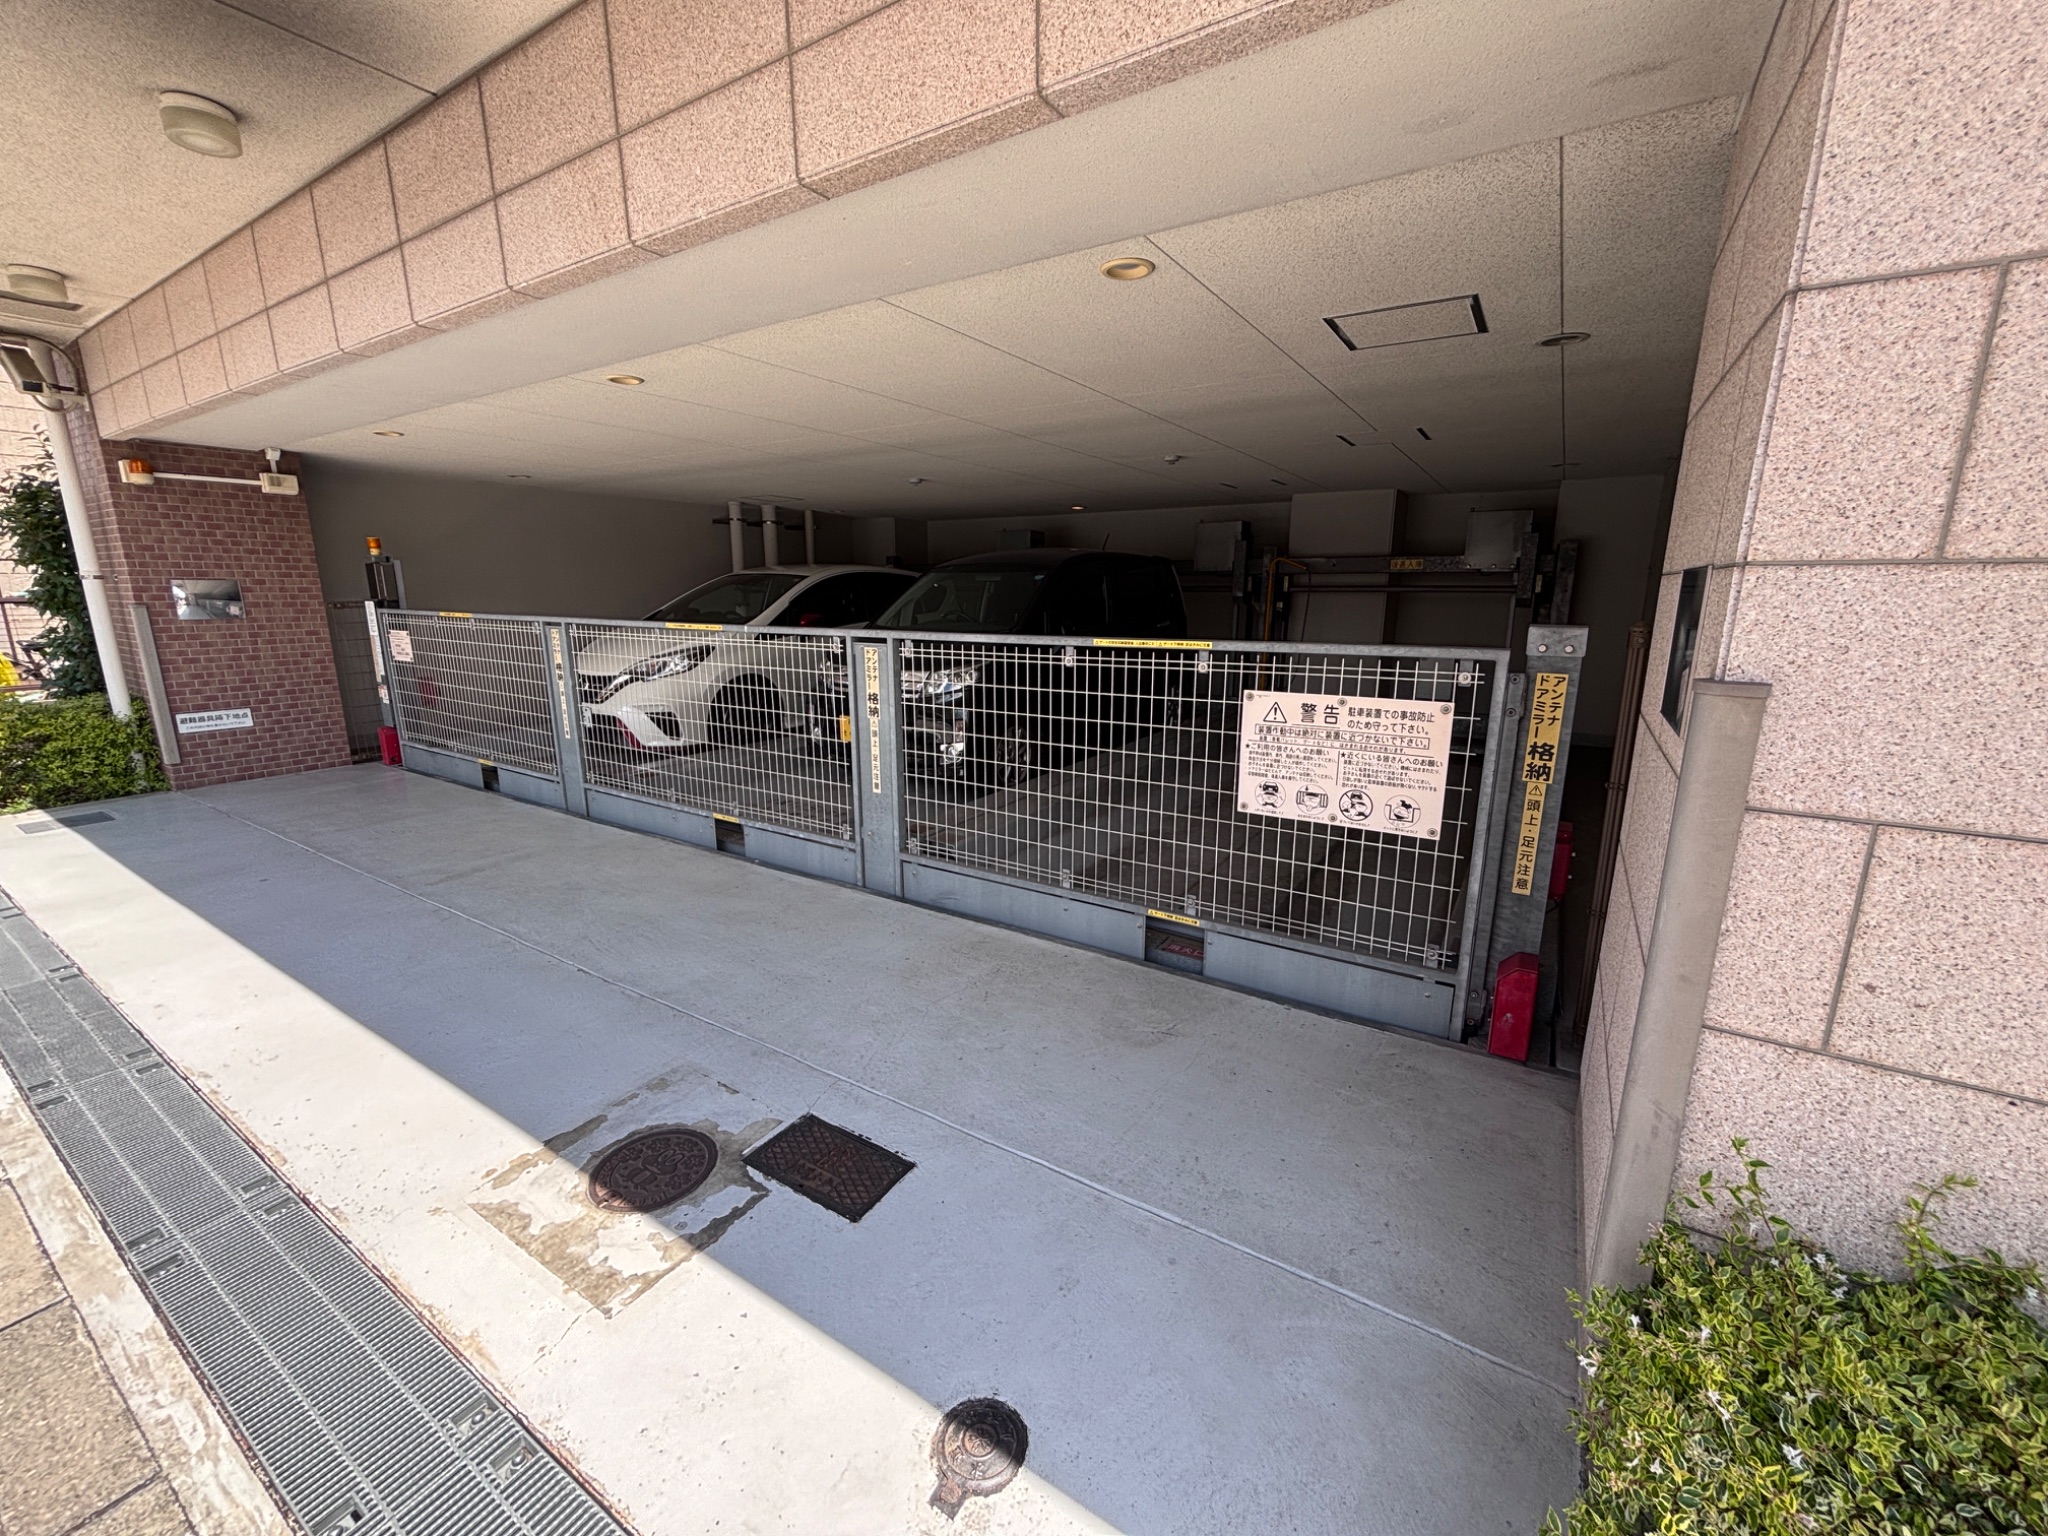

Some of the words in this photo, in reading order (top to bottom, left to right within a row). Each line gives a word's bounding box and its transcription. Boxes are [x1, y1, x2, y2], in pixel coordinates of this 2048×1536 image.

[867, 693, 880, 718] 格納
[1532, 675, 1551, 738] ドアミラー
[1547, 675, 1566, 726] アンテナ
[1300, 702, 1340, 725] 警告
[1348, 707, 1435, 723] 駐車装置での事故防止
[1258, 726, 1427, 748] 装置作動中は絶対に装置に近づかないで下さい。
[1347, 720, 1429, 735] のため守って下さい。
[1525, 741, 1555, 782] 格納
[1514, 799, 1541, 890] 頭上・足元注意
